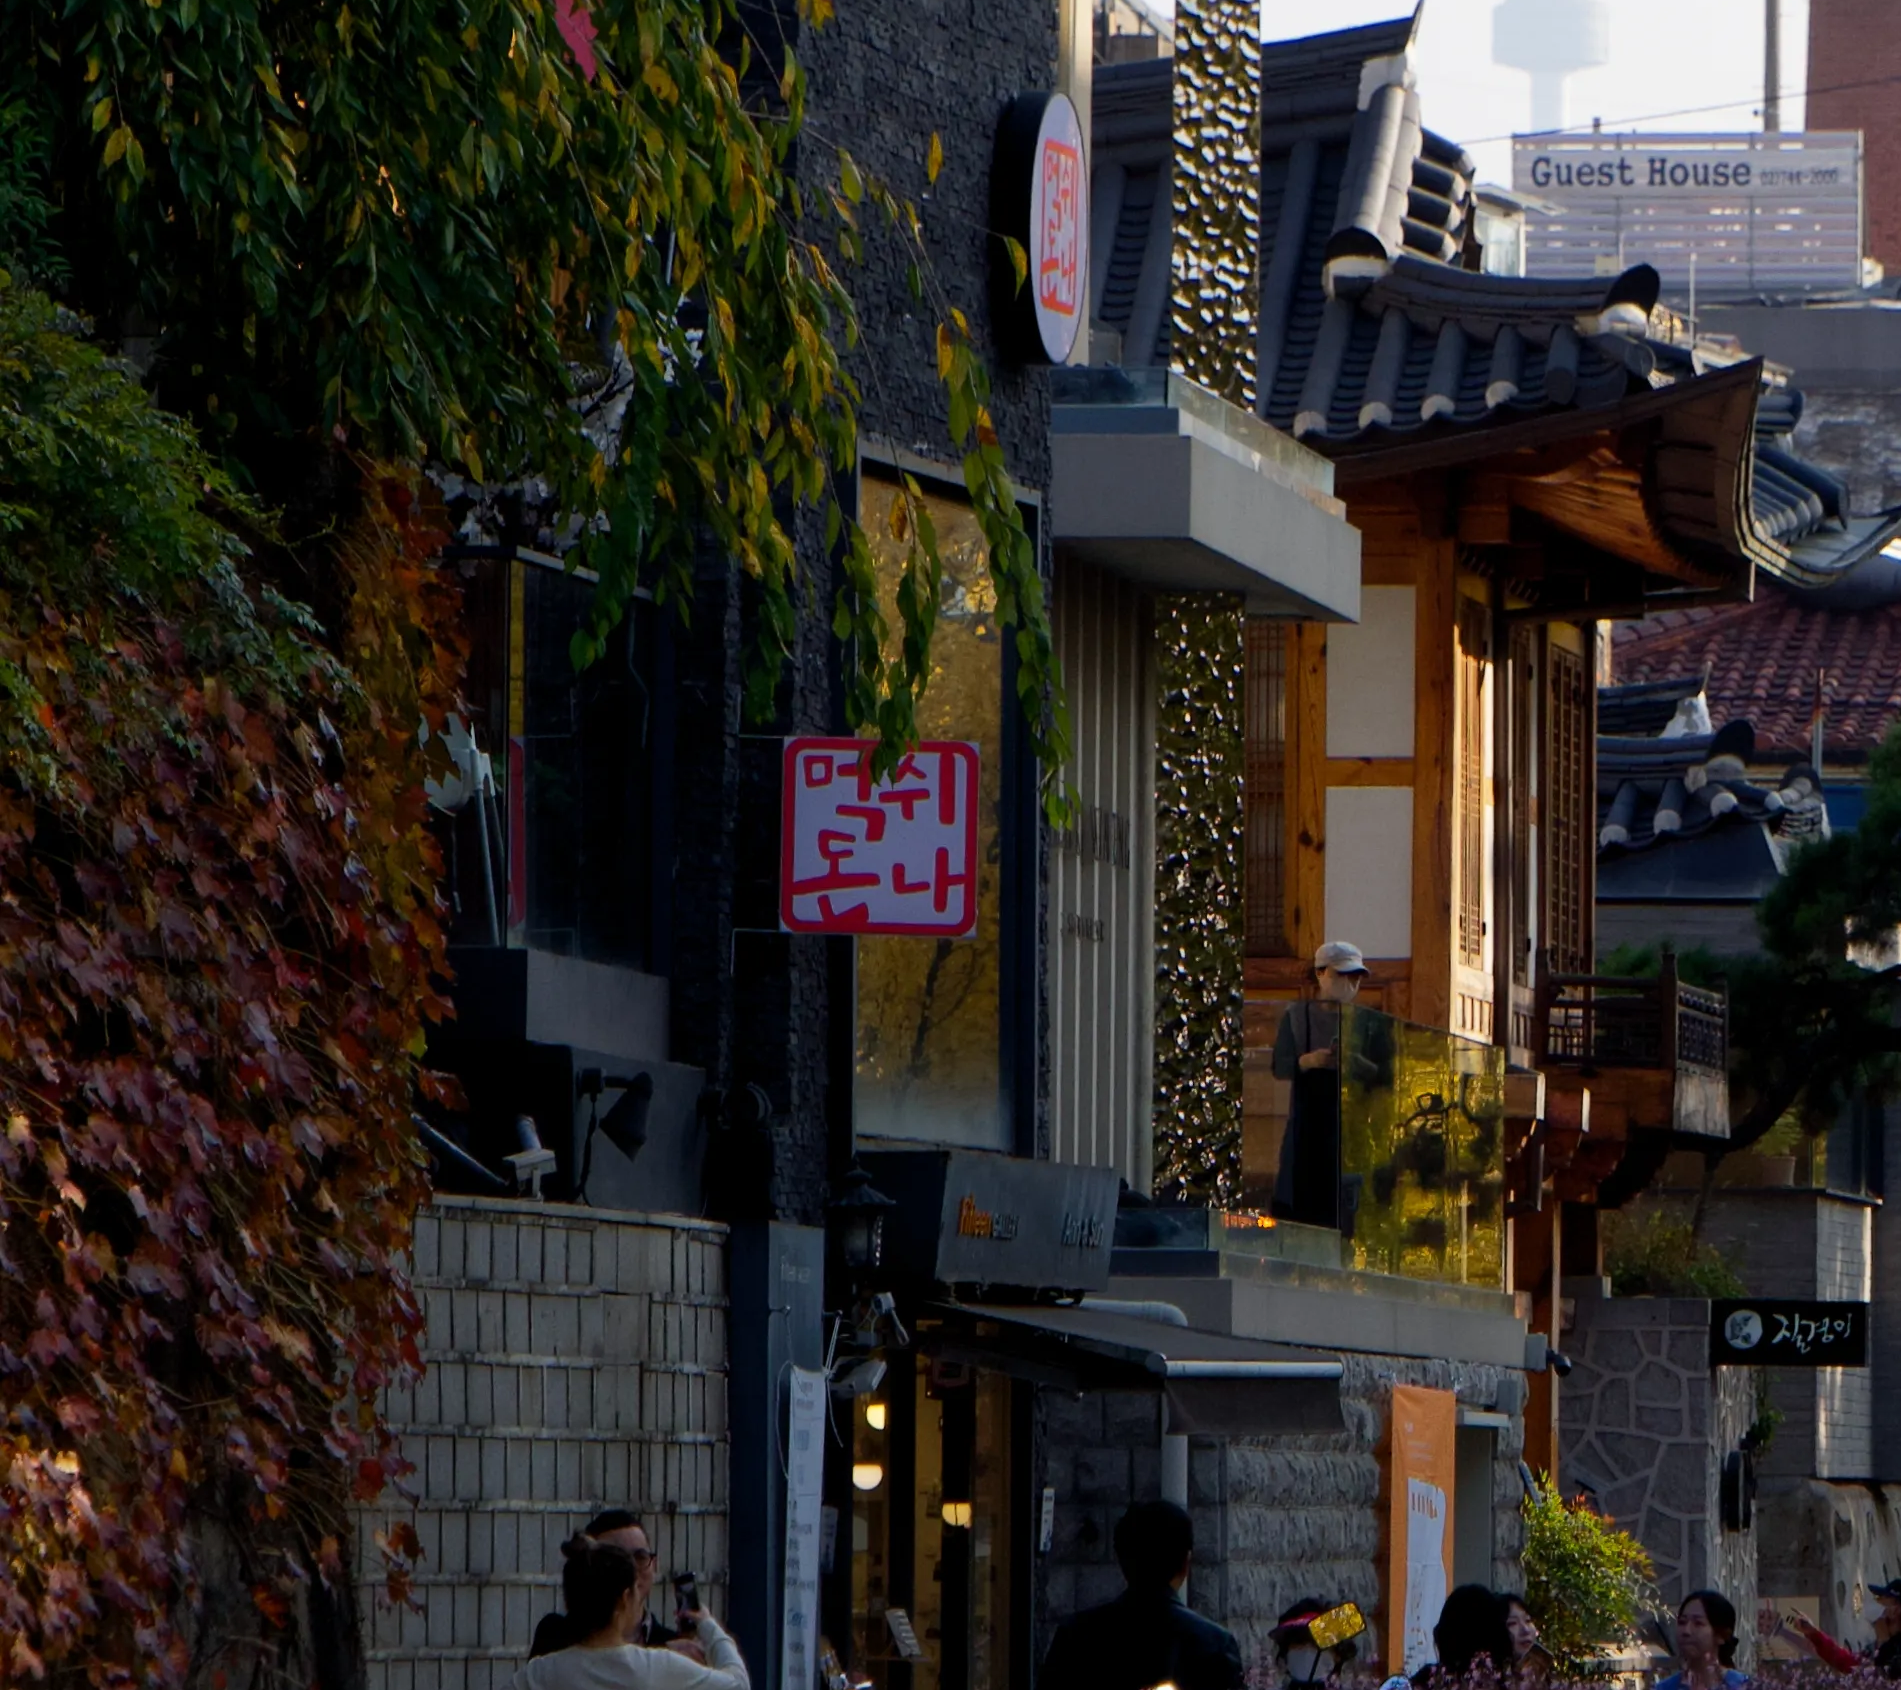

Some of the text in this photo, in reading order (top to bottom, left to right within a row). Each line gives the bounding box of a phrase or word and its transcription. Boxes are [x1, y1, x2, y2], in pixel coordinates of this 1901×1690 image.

[1531, 155, 1634, 188] Guest
[1647, 156, 1752, 187] House
[792, 829, 966, 928] 돈나
